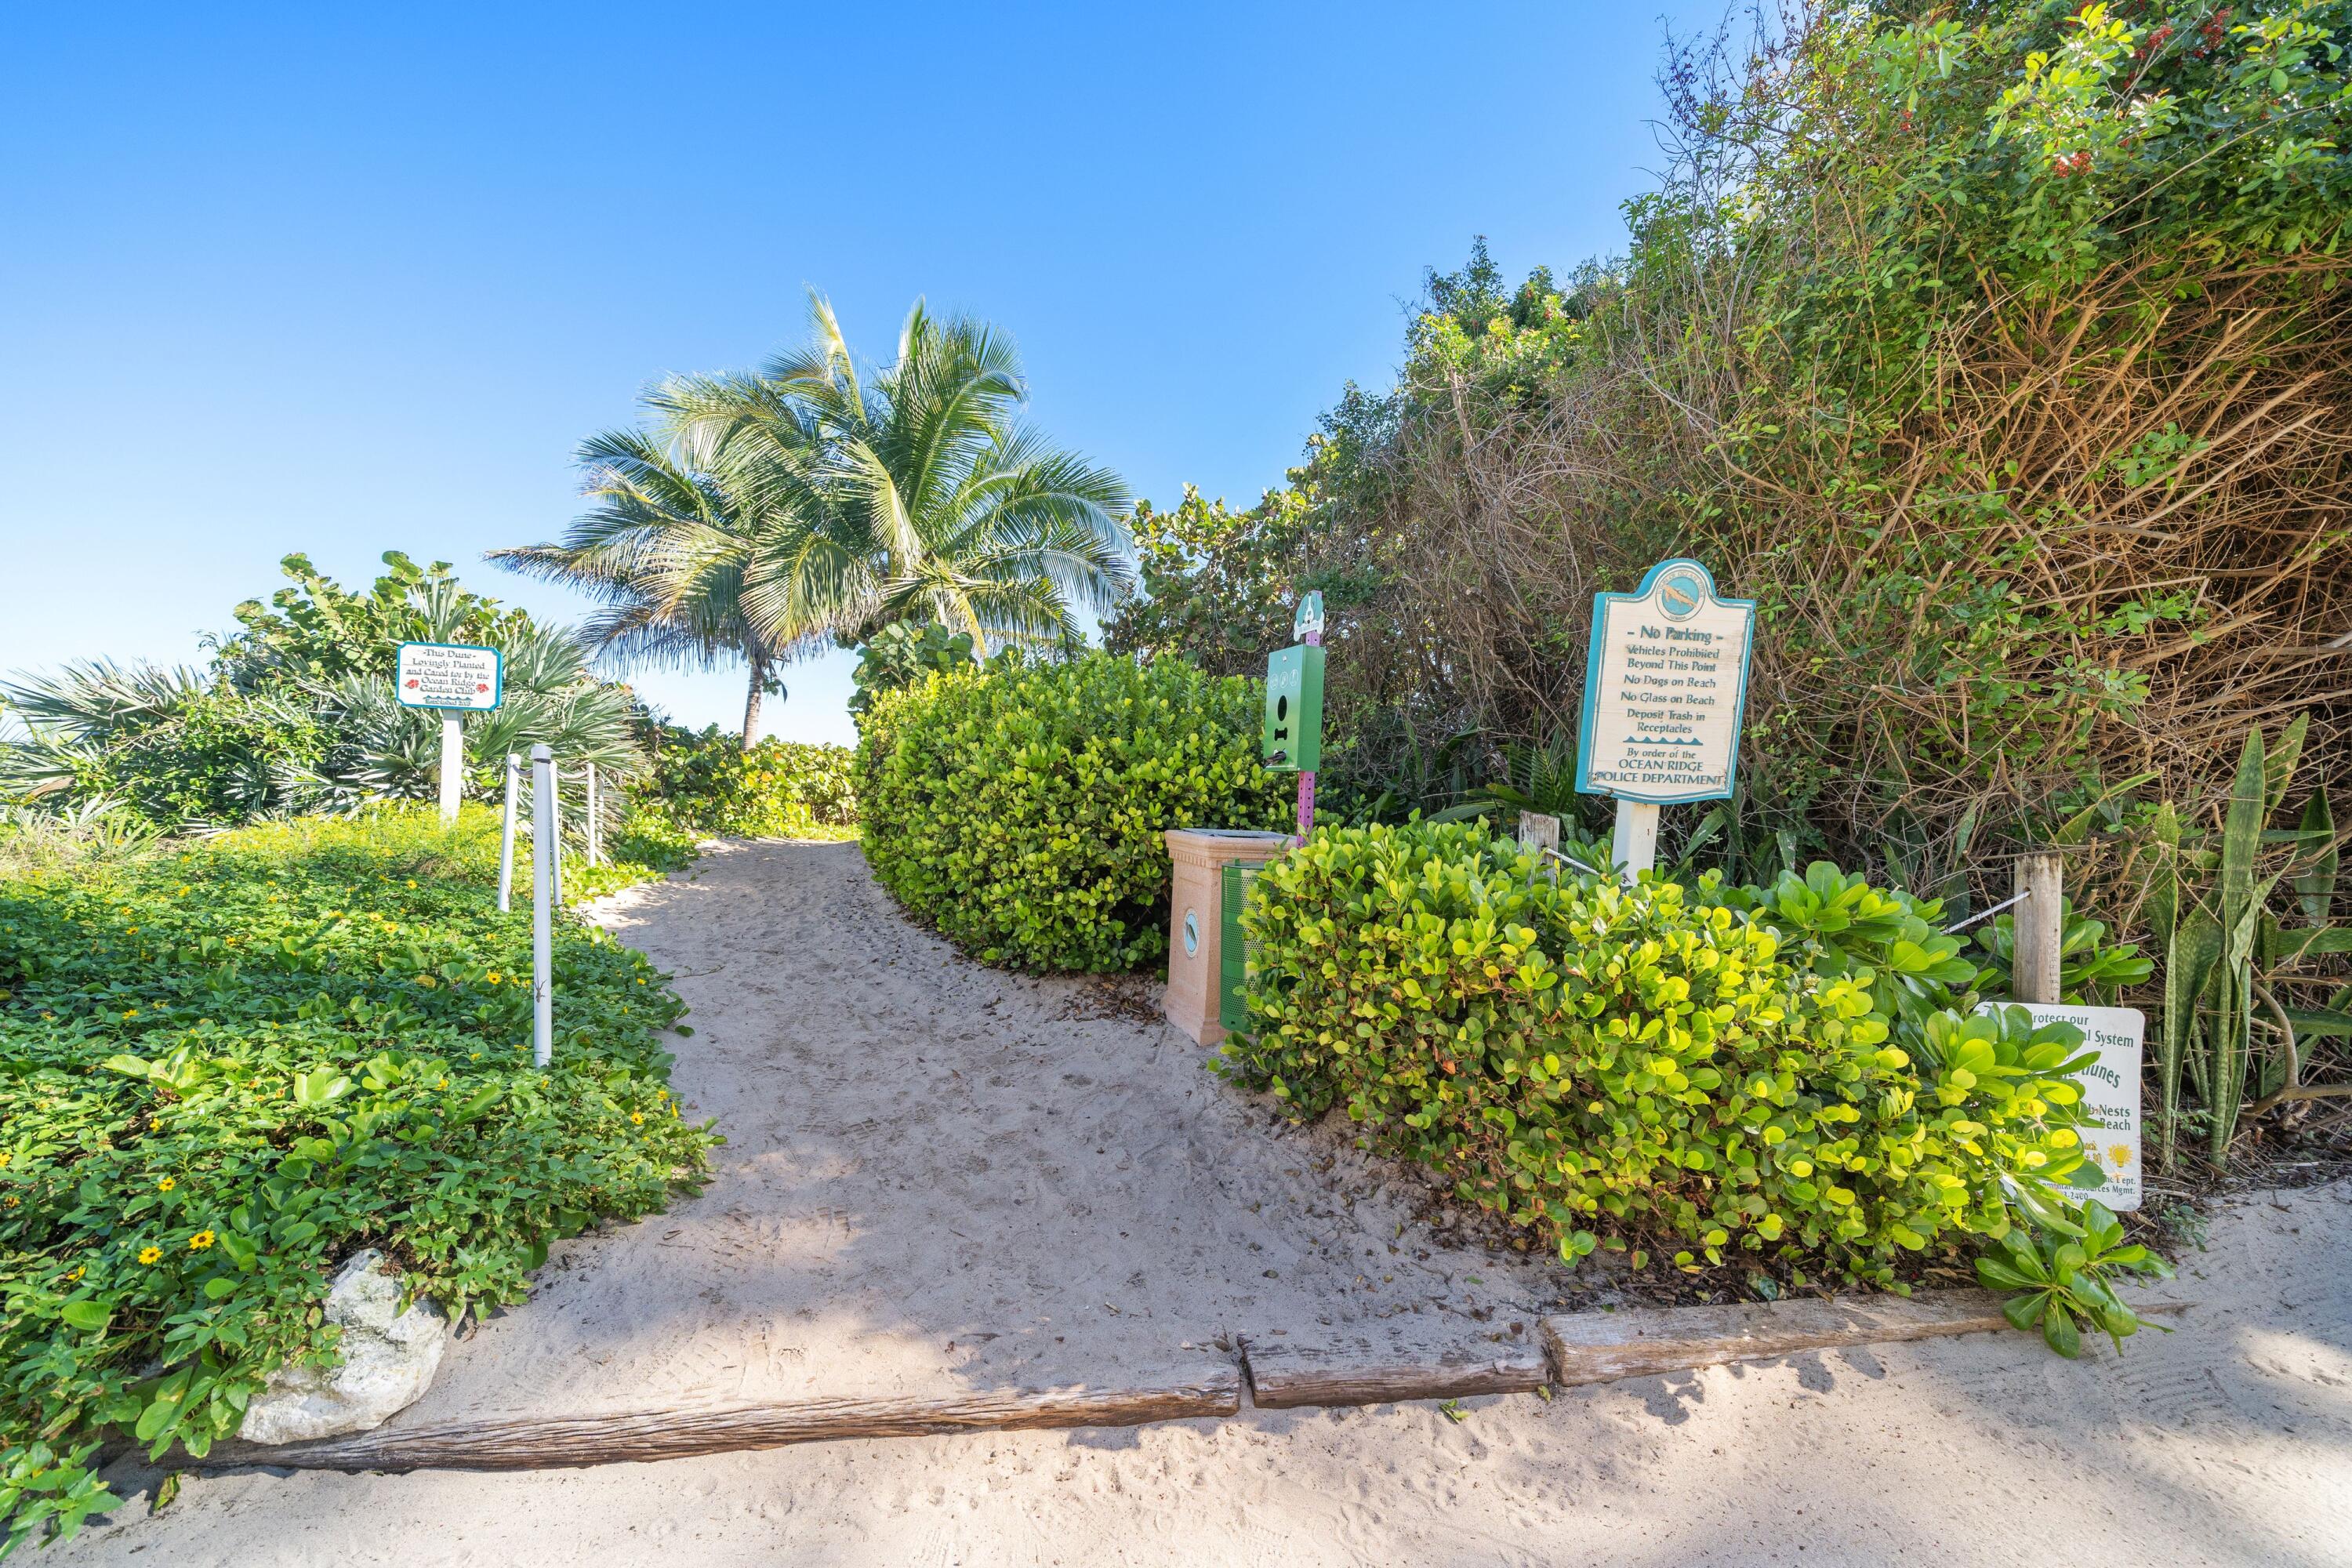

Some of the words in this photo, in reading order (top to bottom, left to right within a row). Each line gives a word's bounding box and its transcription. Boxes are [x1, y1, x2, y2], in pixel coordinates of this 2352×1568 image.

[1640, 625, 1661, 639] No
[1665, 626, 1712, 645] Parking
[1626, 644, 1666, 656] Vehicles
[1669, 646, 1719, 659] Prohibited
[412, 658, 451, 669] Lovingly
[453, 660, 485, 669] Planted
[1627, 658, 1664, 670] Beyond
[1668, 659, 1689, 670] This
[1692, 661, 1716, 672] Point
[464, 671, 474, 680] by
[1624, 674, 1640, 684] No
[1643, 675, 1668, 688] Dogs
[1687, 677, 1716, 688] Beach
[421, 677, 448, 685] Ocean
[451, 678, 476, 688] Ridge
[419, 684, 452, 693] Garden
[455, 686, 476, 695] Club
[1621, 691, 1636, 702] No
[1640, 692, 1668, 703] Glass
[1670, 695, 1683, 704] on
[1686, 694, 1715, 706] Beach
[1627, 708, 1664, 720] Deposit
[1668, 710, 1693, 720] Trash
[1696, 712, 1705, 721] in
[1637, 721, 1693, 734] Receptacles
[1627, 747, 1639, 757] By
[1642, 749, 1666, 757] order
[1669, 748, 1678, 758] of
[1682, 750, 1697, 759] the
[1618, 759, 1664, 771] OCEAN
[1667, 760, 1704, 772] RIDGE
[1596, 771, 1638, 782] POLICE
[1642, 773, 1723, 786] DEPARTMENT
[2034, 1013, 2066, 1023] rotect
[2070, 1016, 2089, 1025] our
[2095, 1030, 2133, 1047] System
[2099, 1104, 2130, 1117] Nests
[2112, 1185, 2136, 1196] Mgmt.
